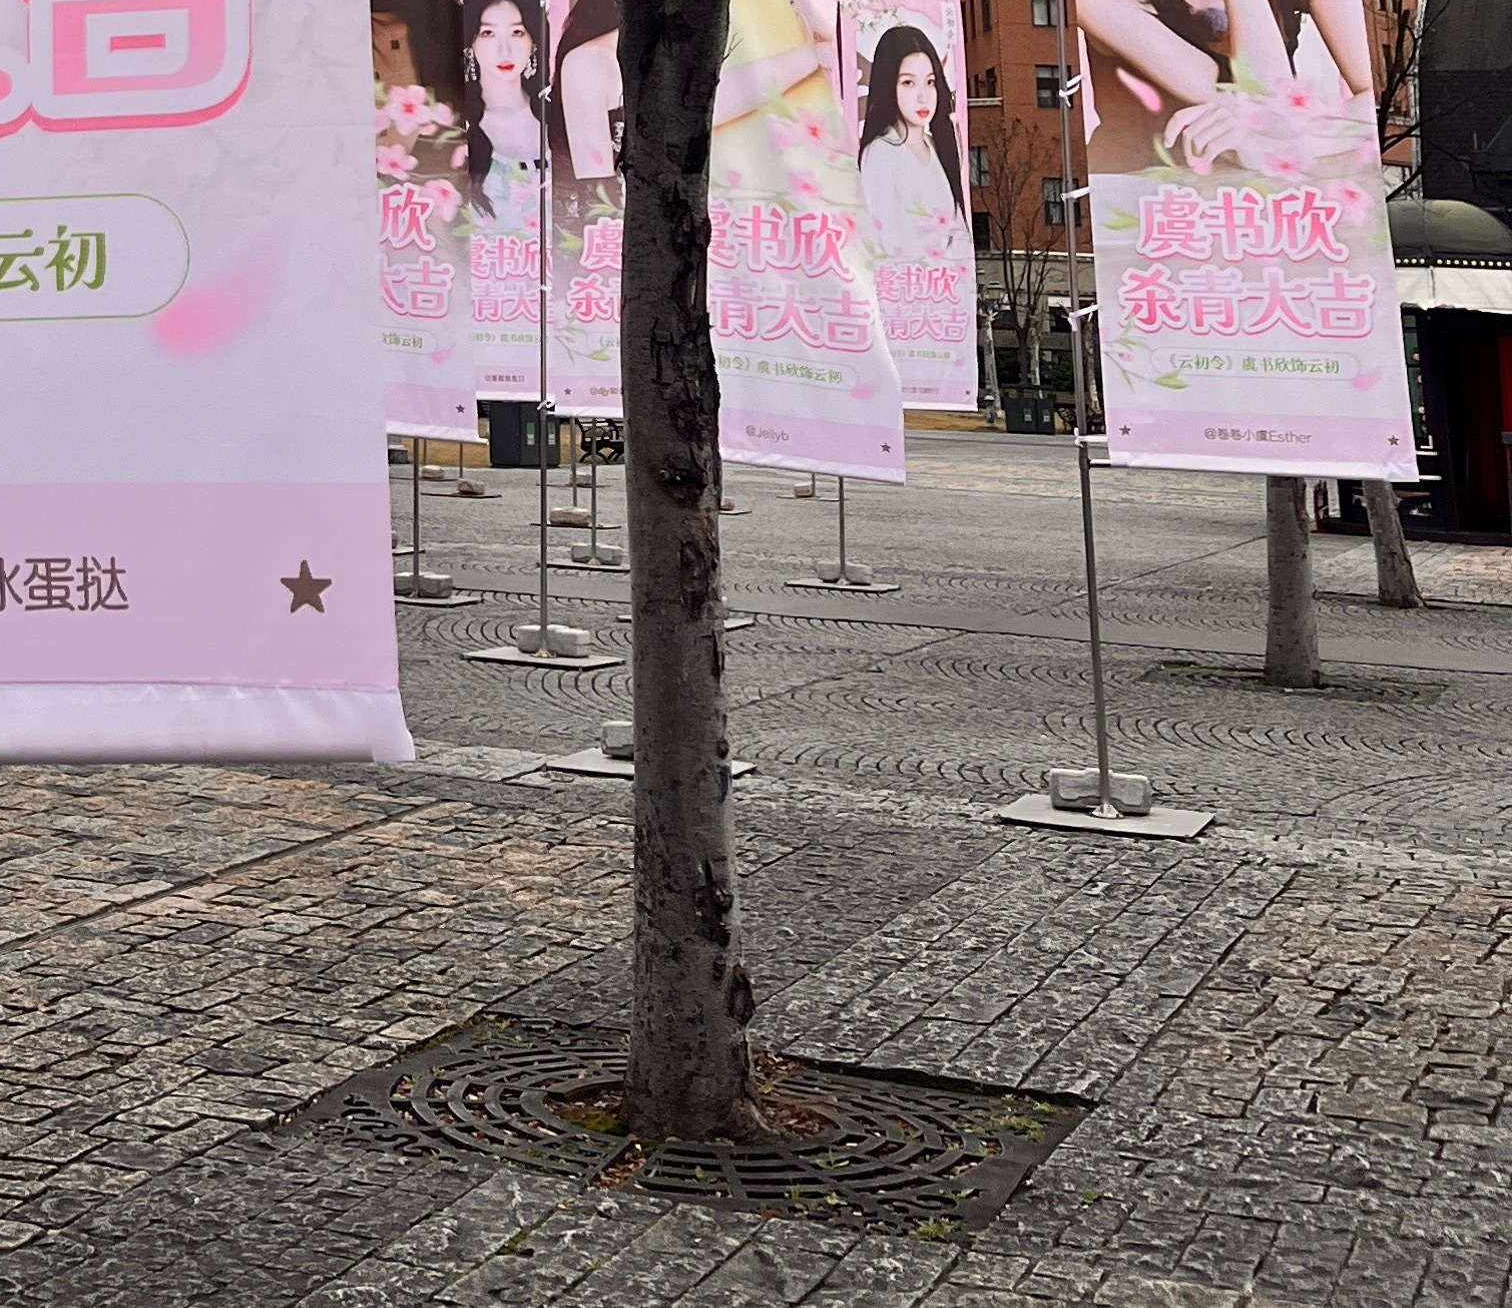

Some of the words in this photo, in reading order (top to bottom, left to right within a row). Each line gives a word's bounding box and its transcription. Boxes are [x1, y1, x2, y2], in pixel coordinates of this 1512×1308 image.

[1138, 185, 1348, 262] 虞书欣
[567, 273, 622, 323] 杀
[1119, 264, 1374, 337] 杀青大吉
